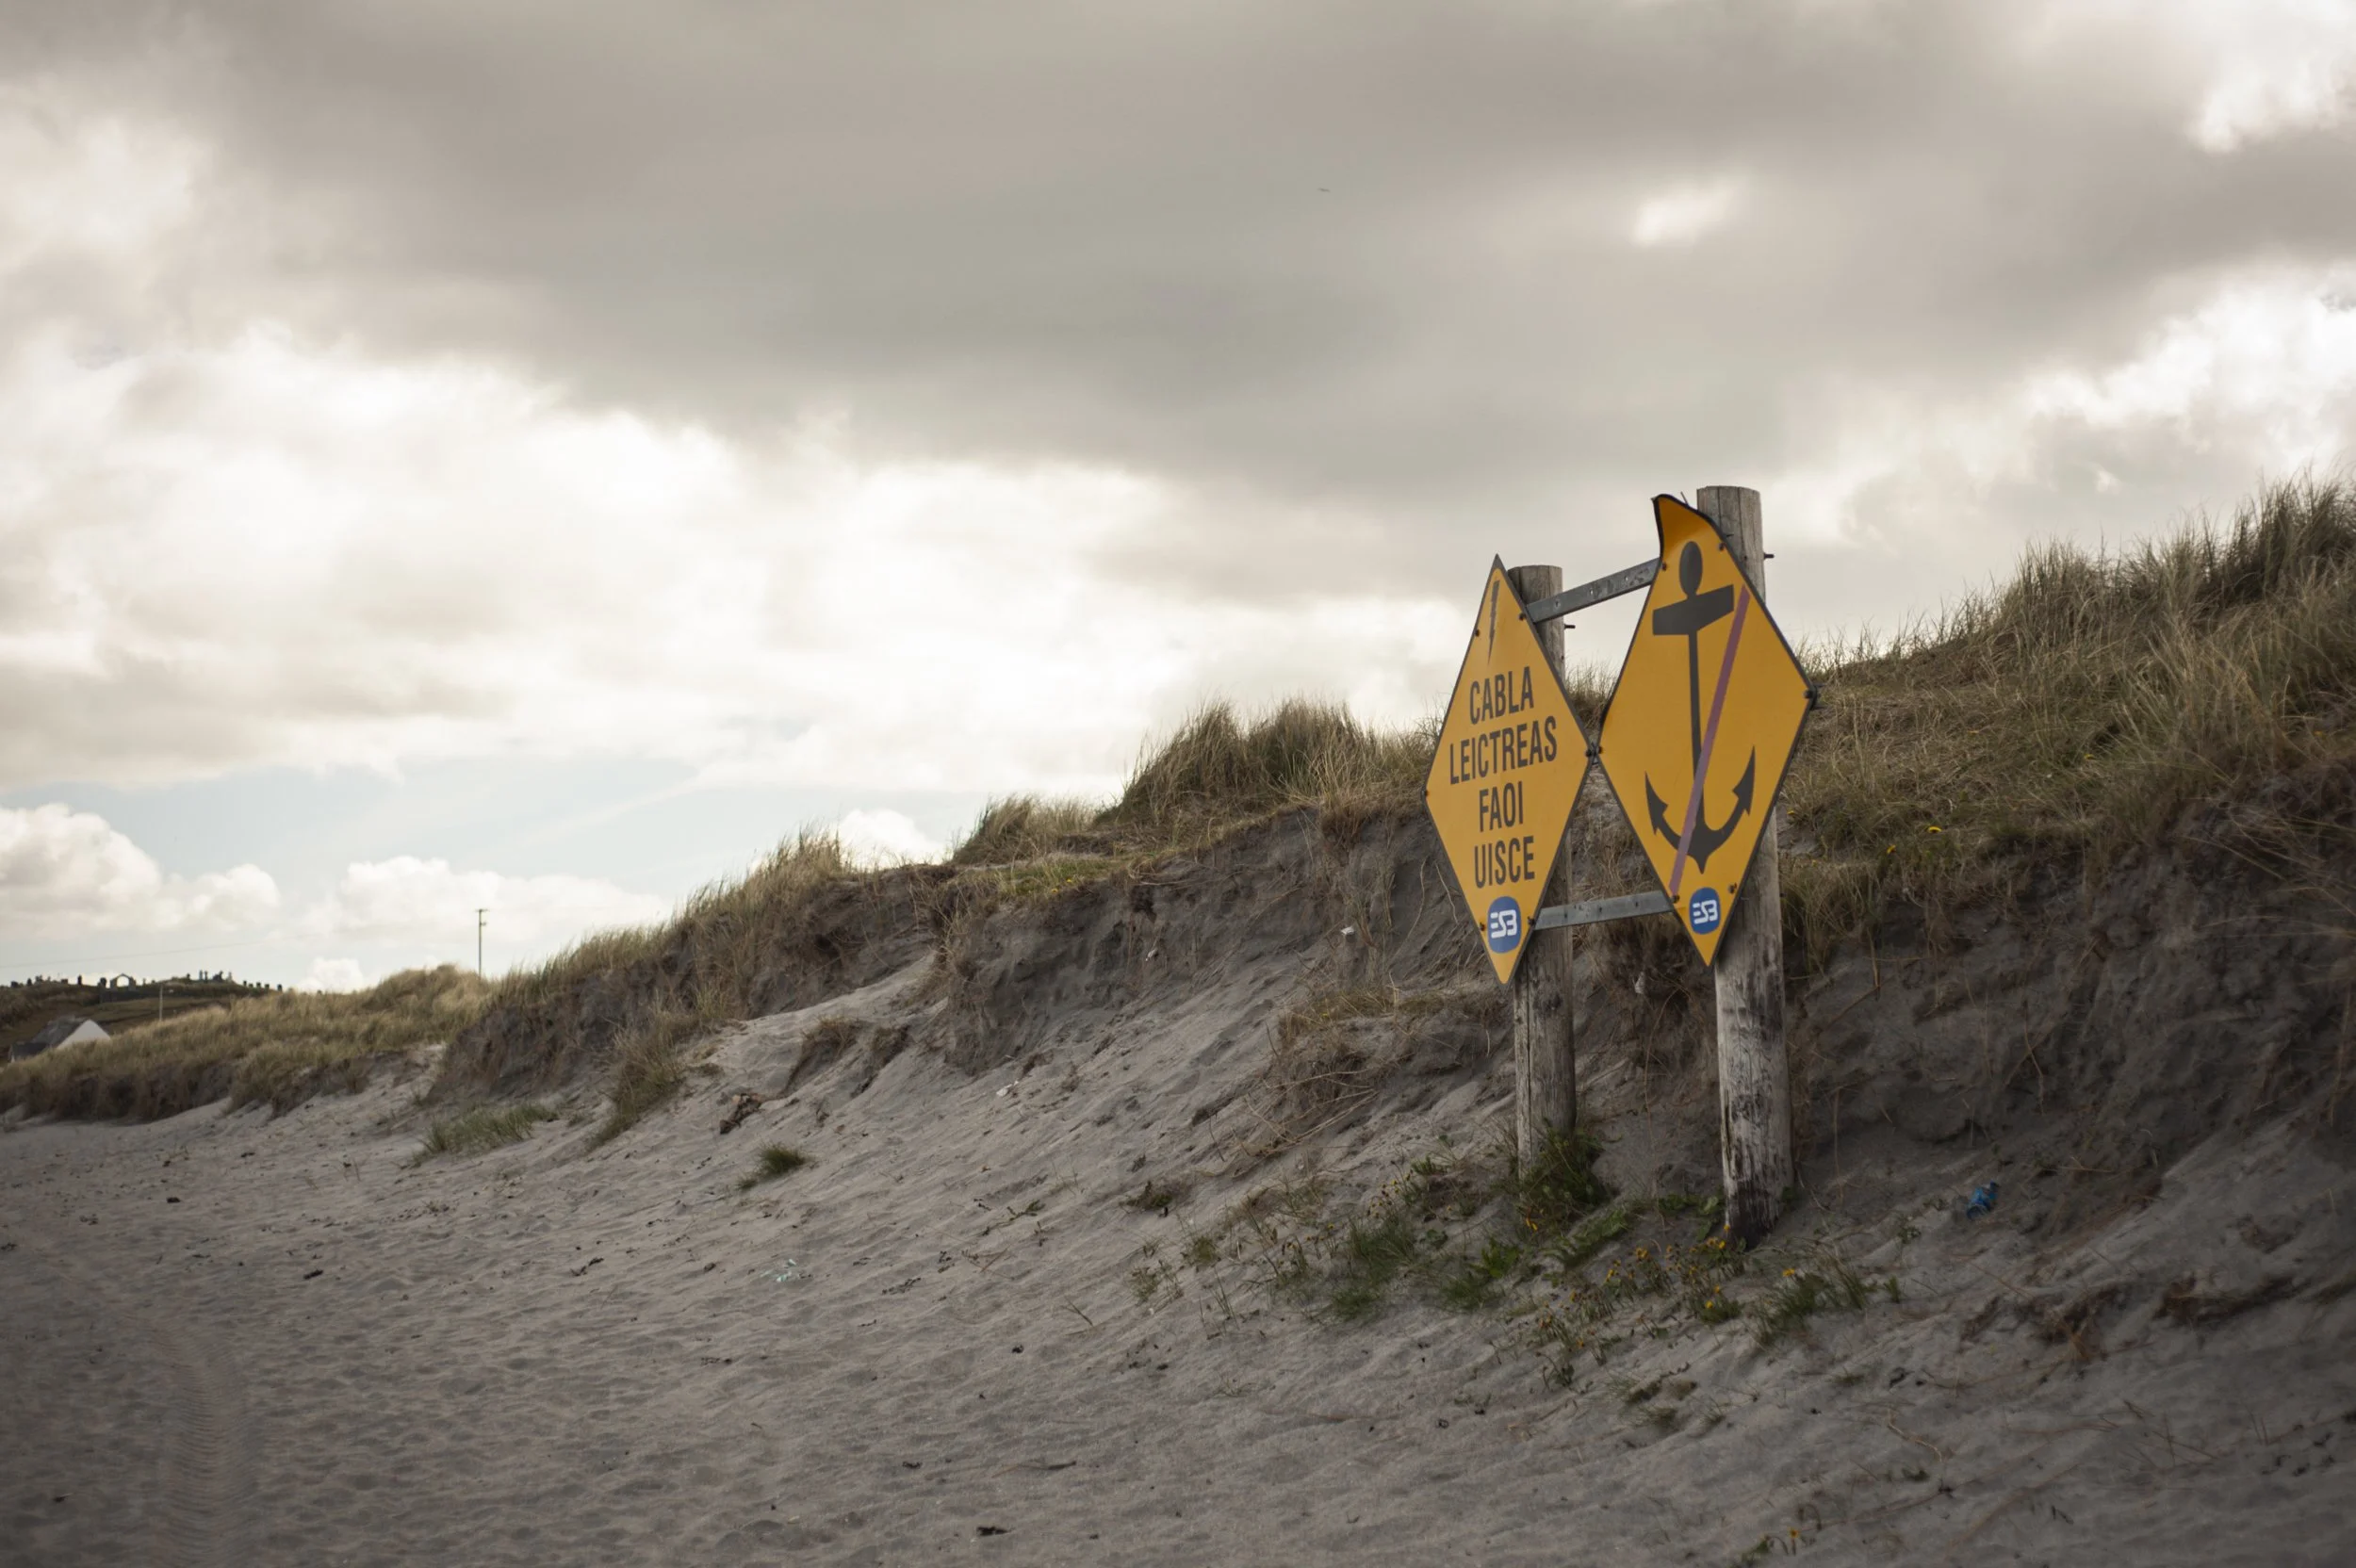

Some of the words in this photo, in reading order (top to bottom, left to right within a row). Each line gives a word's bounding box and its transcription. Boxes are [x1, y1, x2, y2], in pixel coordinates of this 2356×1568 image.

[1469, 665, 1534, 726] CABLA
[1449, 715, 1558, 785] LEICTREAS
[1479, 780, 1524, 833] FAOI
[1474, 835, 1535, 890] UISCE
